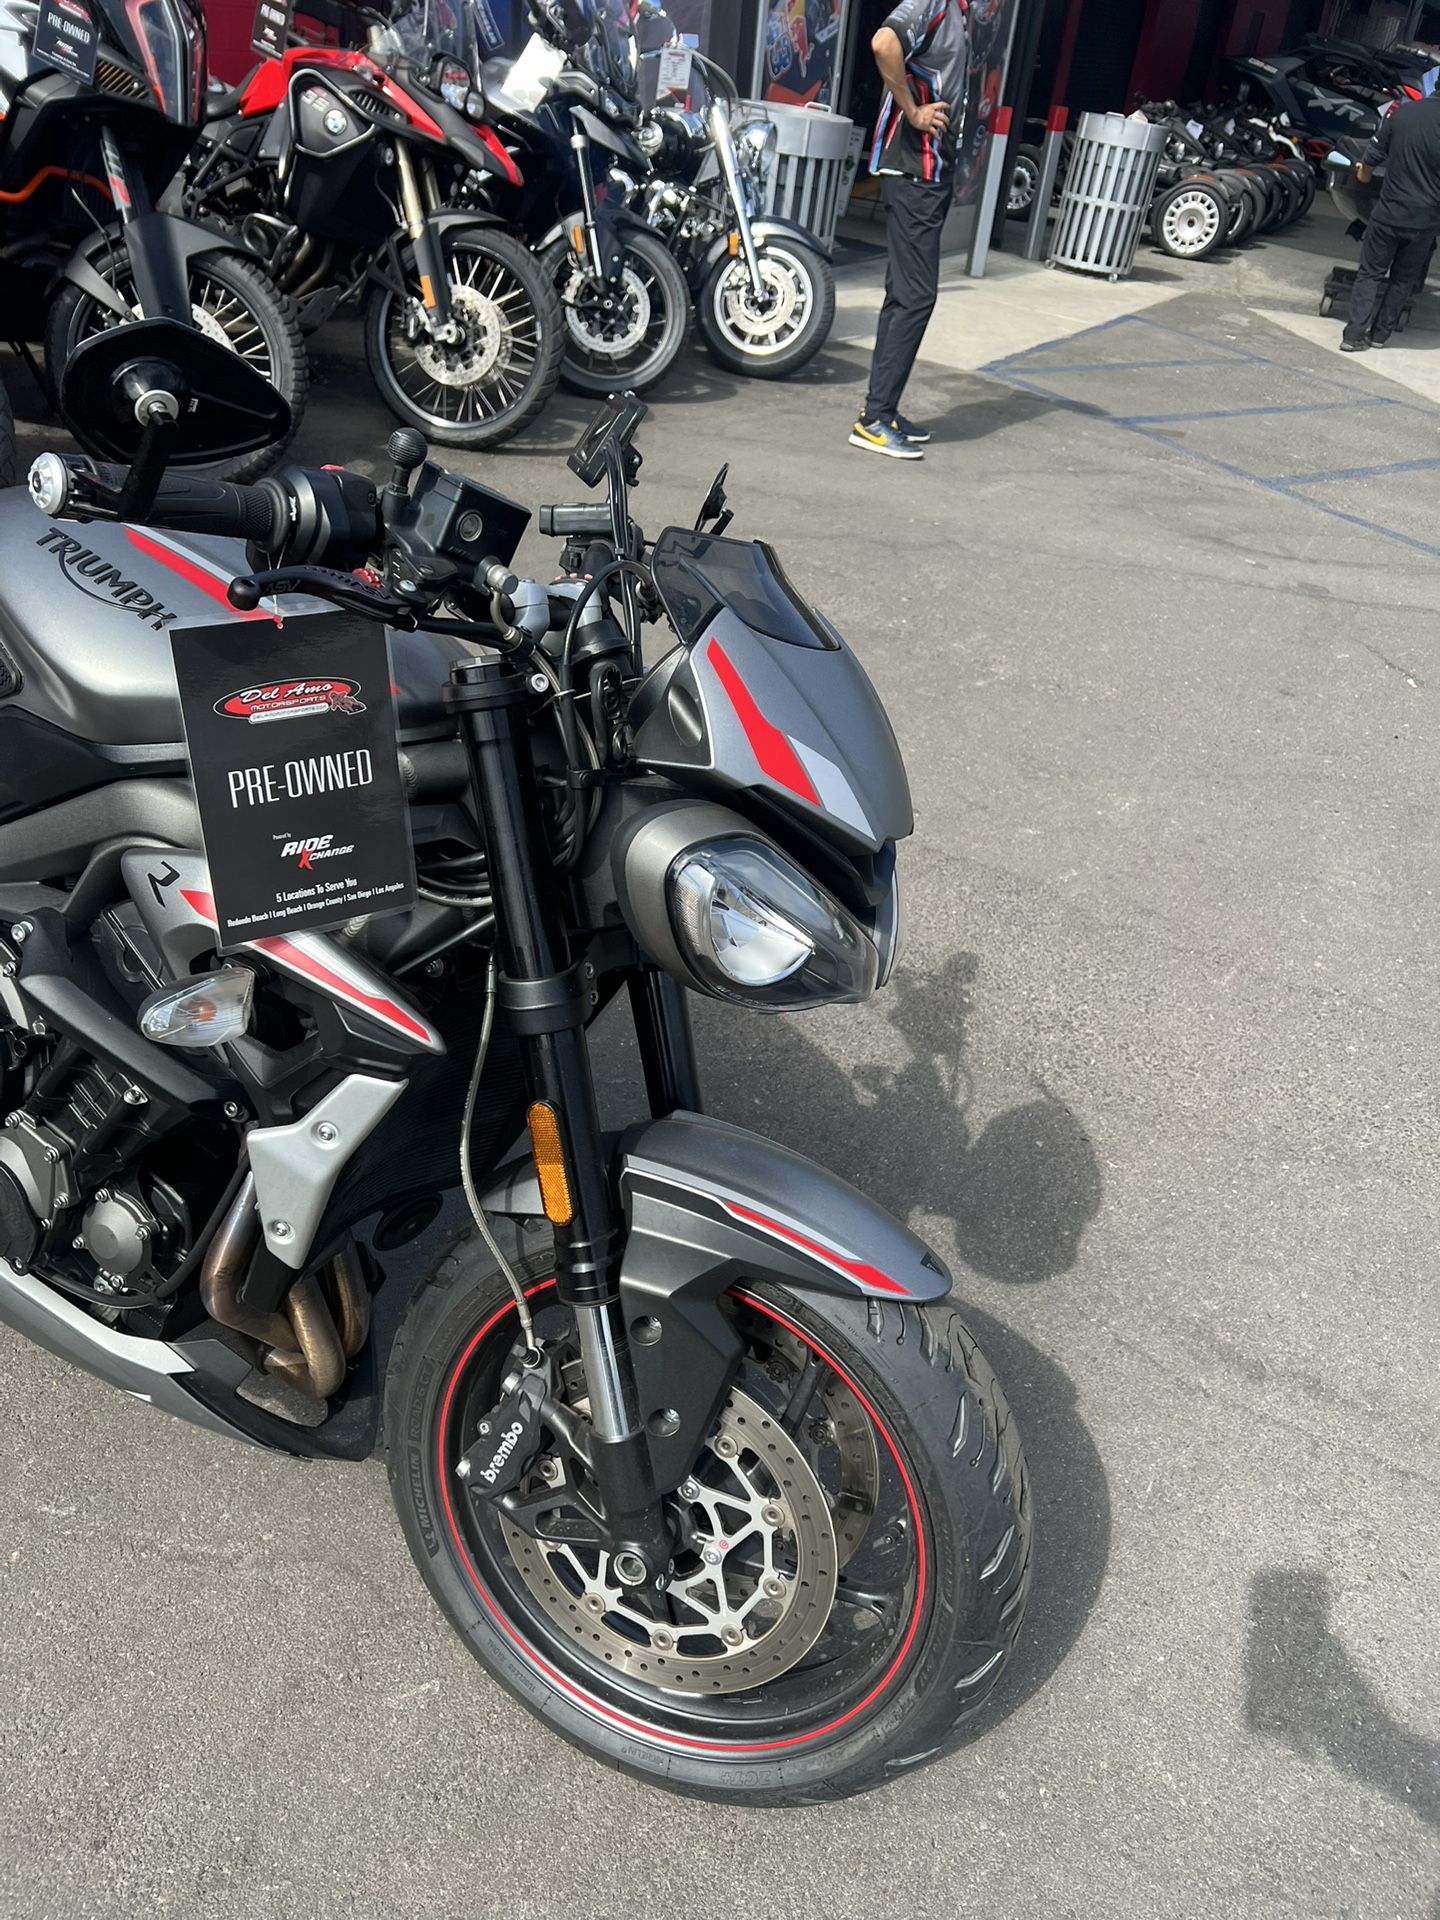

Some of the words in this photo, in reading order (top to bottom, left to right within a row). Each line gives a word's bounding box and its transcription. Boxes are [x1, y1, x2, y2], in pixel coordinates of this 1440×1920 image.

[36, 528, 177, 631] TRIUMPH
[240, 688, 280, 703] Del
[284, 682, 333, 698] Amo
[251, 695, 326, 711] MOTORSPORTS
[228, 749, 374, 808] PRE-OWNED
[281, 835, 333, 857] RIDE
[251, 912, 269, 922] Beach
[273, 910, 286, 918] Long
[286, 905, 303, 915] Beach
[306, 901, 325, 911] Orange
[325, 897, 343, 906] County
[347, 893, 357, 901] San
[357, 890, 372, 898] Diego
[385, 882, 404, 892] Angeles
[276, 893, 282, 902] 5
[283, 888, 316, 901] Locations
[315, 884, 325, 894] To
[325, 881, 345, 892] Serve
[345, 878, 357, 887] You
[410, 1400, 424, 1436] ROAD
[480, 1421, 524, 1484] brembo
[409, 1452, 431, 1529] MICHELIN
